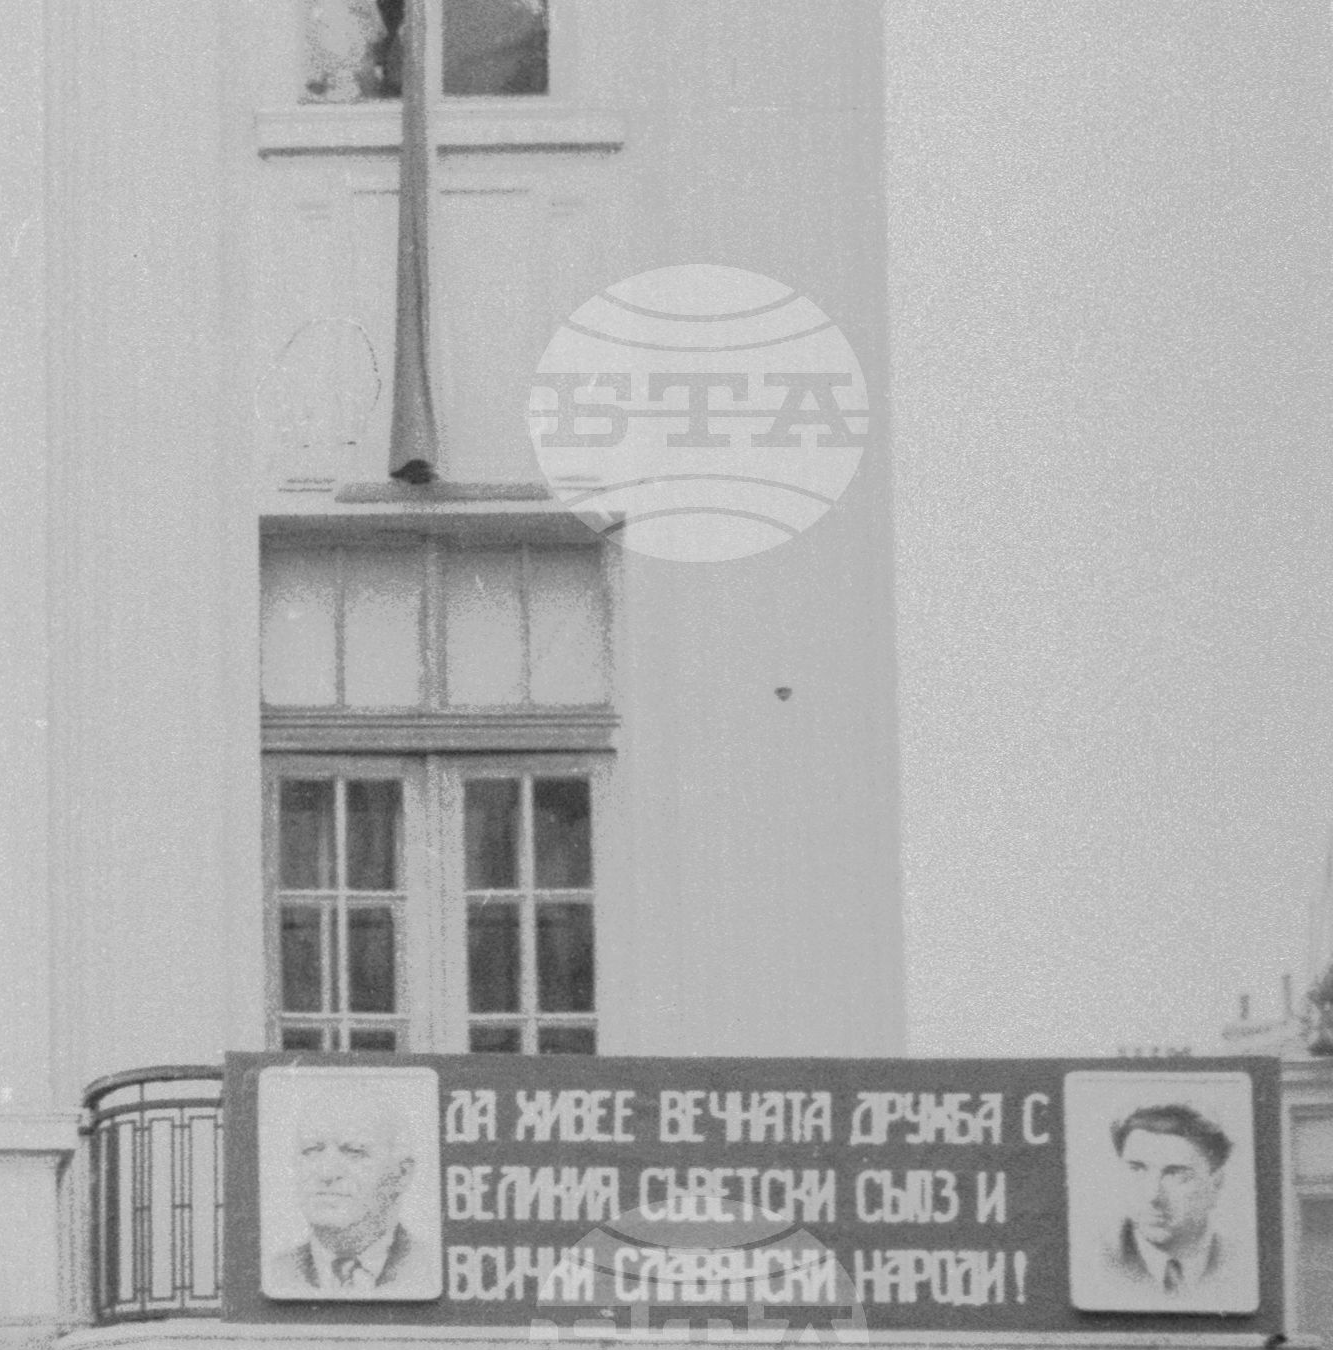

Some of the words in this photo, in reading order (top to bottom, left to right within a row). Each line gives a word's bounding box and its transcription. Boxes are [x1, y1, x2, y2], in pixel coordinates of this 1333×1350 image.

[446, 1089, 497, 1143] ДА
[516, 1089, 635, 1142] ЖИВЕЕ
[659, 1090, 832, 1144] ВЕЧНАТА
[850, 1091, 1003, 1145] ДРУЖБА
[1023, 1093, 1050, 1145] С
[446, 1166, 620, 1222] ВЕЛИКИЯ
[639, 1167, 836, 1223] СЪВЕТСКИ
[855, 1169, 960, 1224] СЪЮЗ
[977, 1171, 1007, 1224] И
[447, 1246, 595, 1302] ВСИЧКИ
[614, 1247, 836, 1303] СЛАВЯНСКИ
[853, 1249, 1028, 1306] НАРОДИ!
